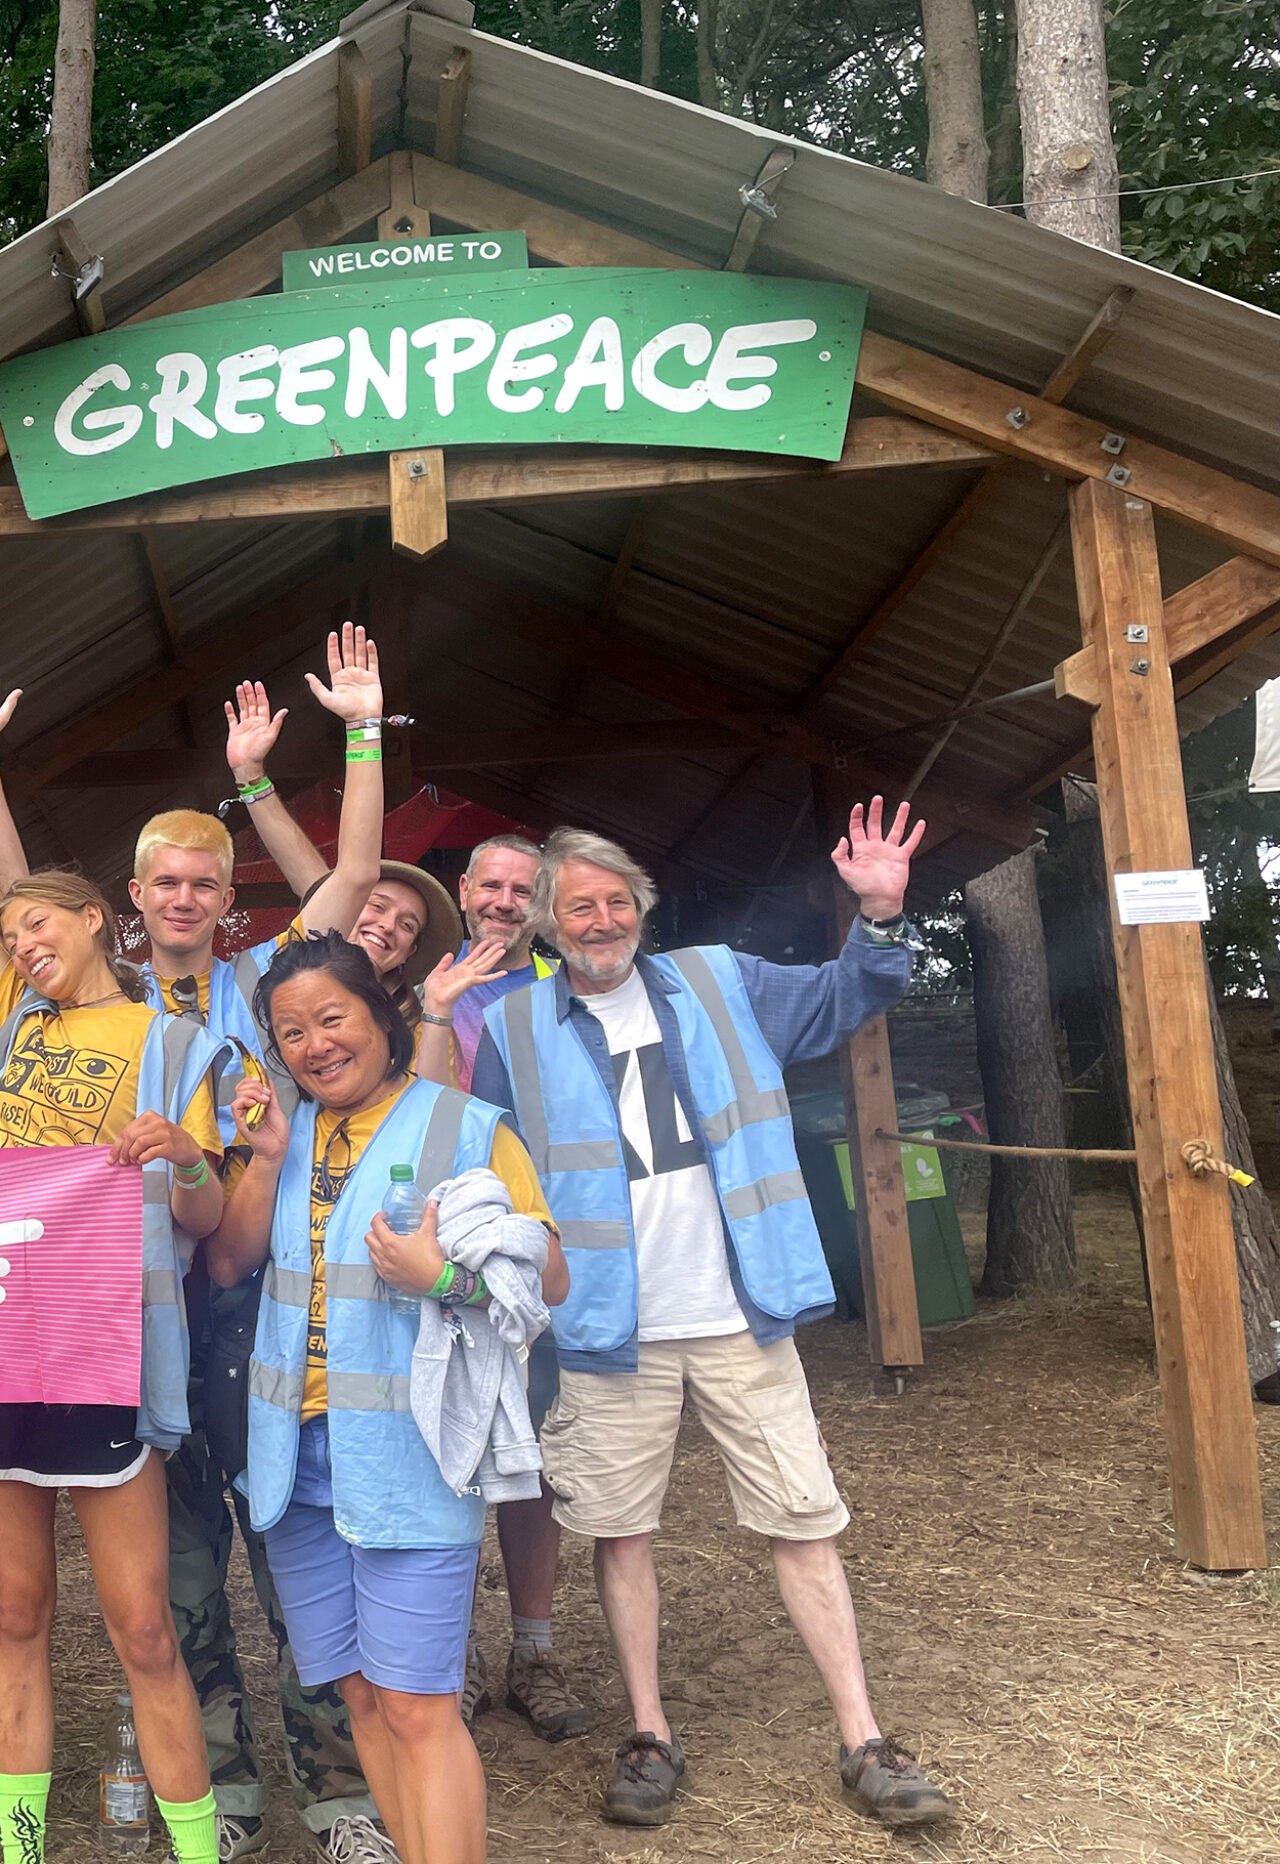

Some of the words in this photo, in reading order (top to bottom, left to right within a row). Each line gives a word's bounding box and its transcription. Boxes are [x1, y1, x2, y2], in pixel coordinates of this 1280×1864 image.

[307, 244, 455, 278] WELCOME
[460, 240, 502, 262] TO
[52, 313, 818, 456] GREENPEACE
